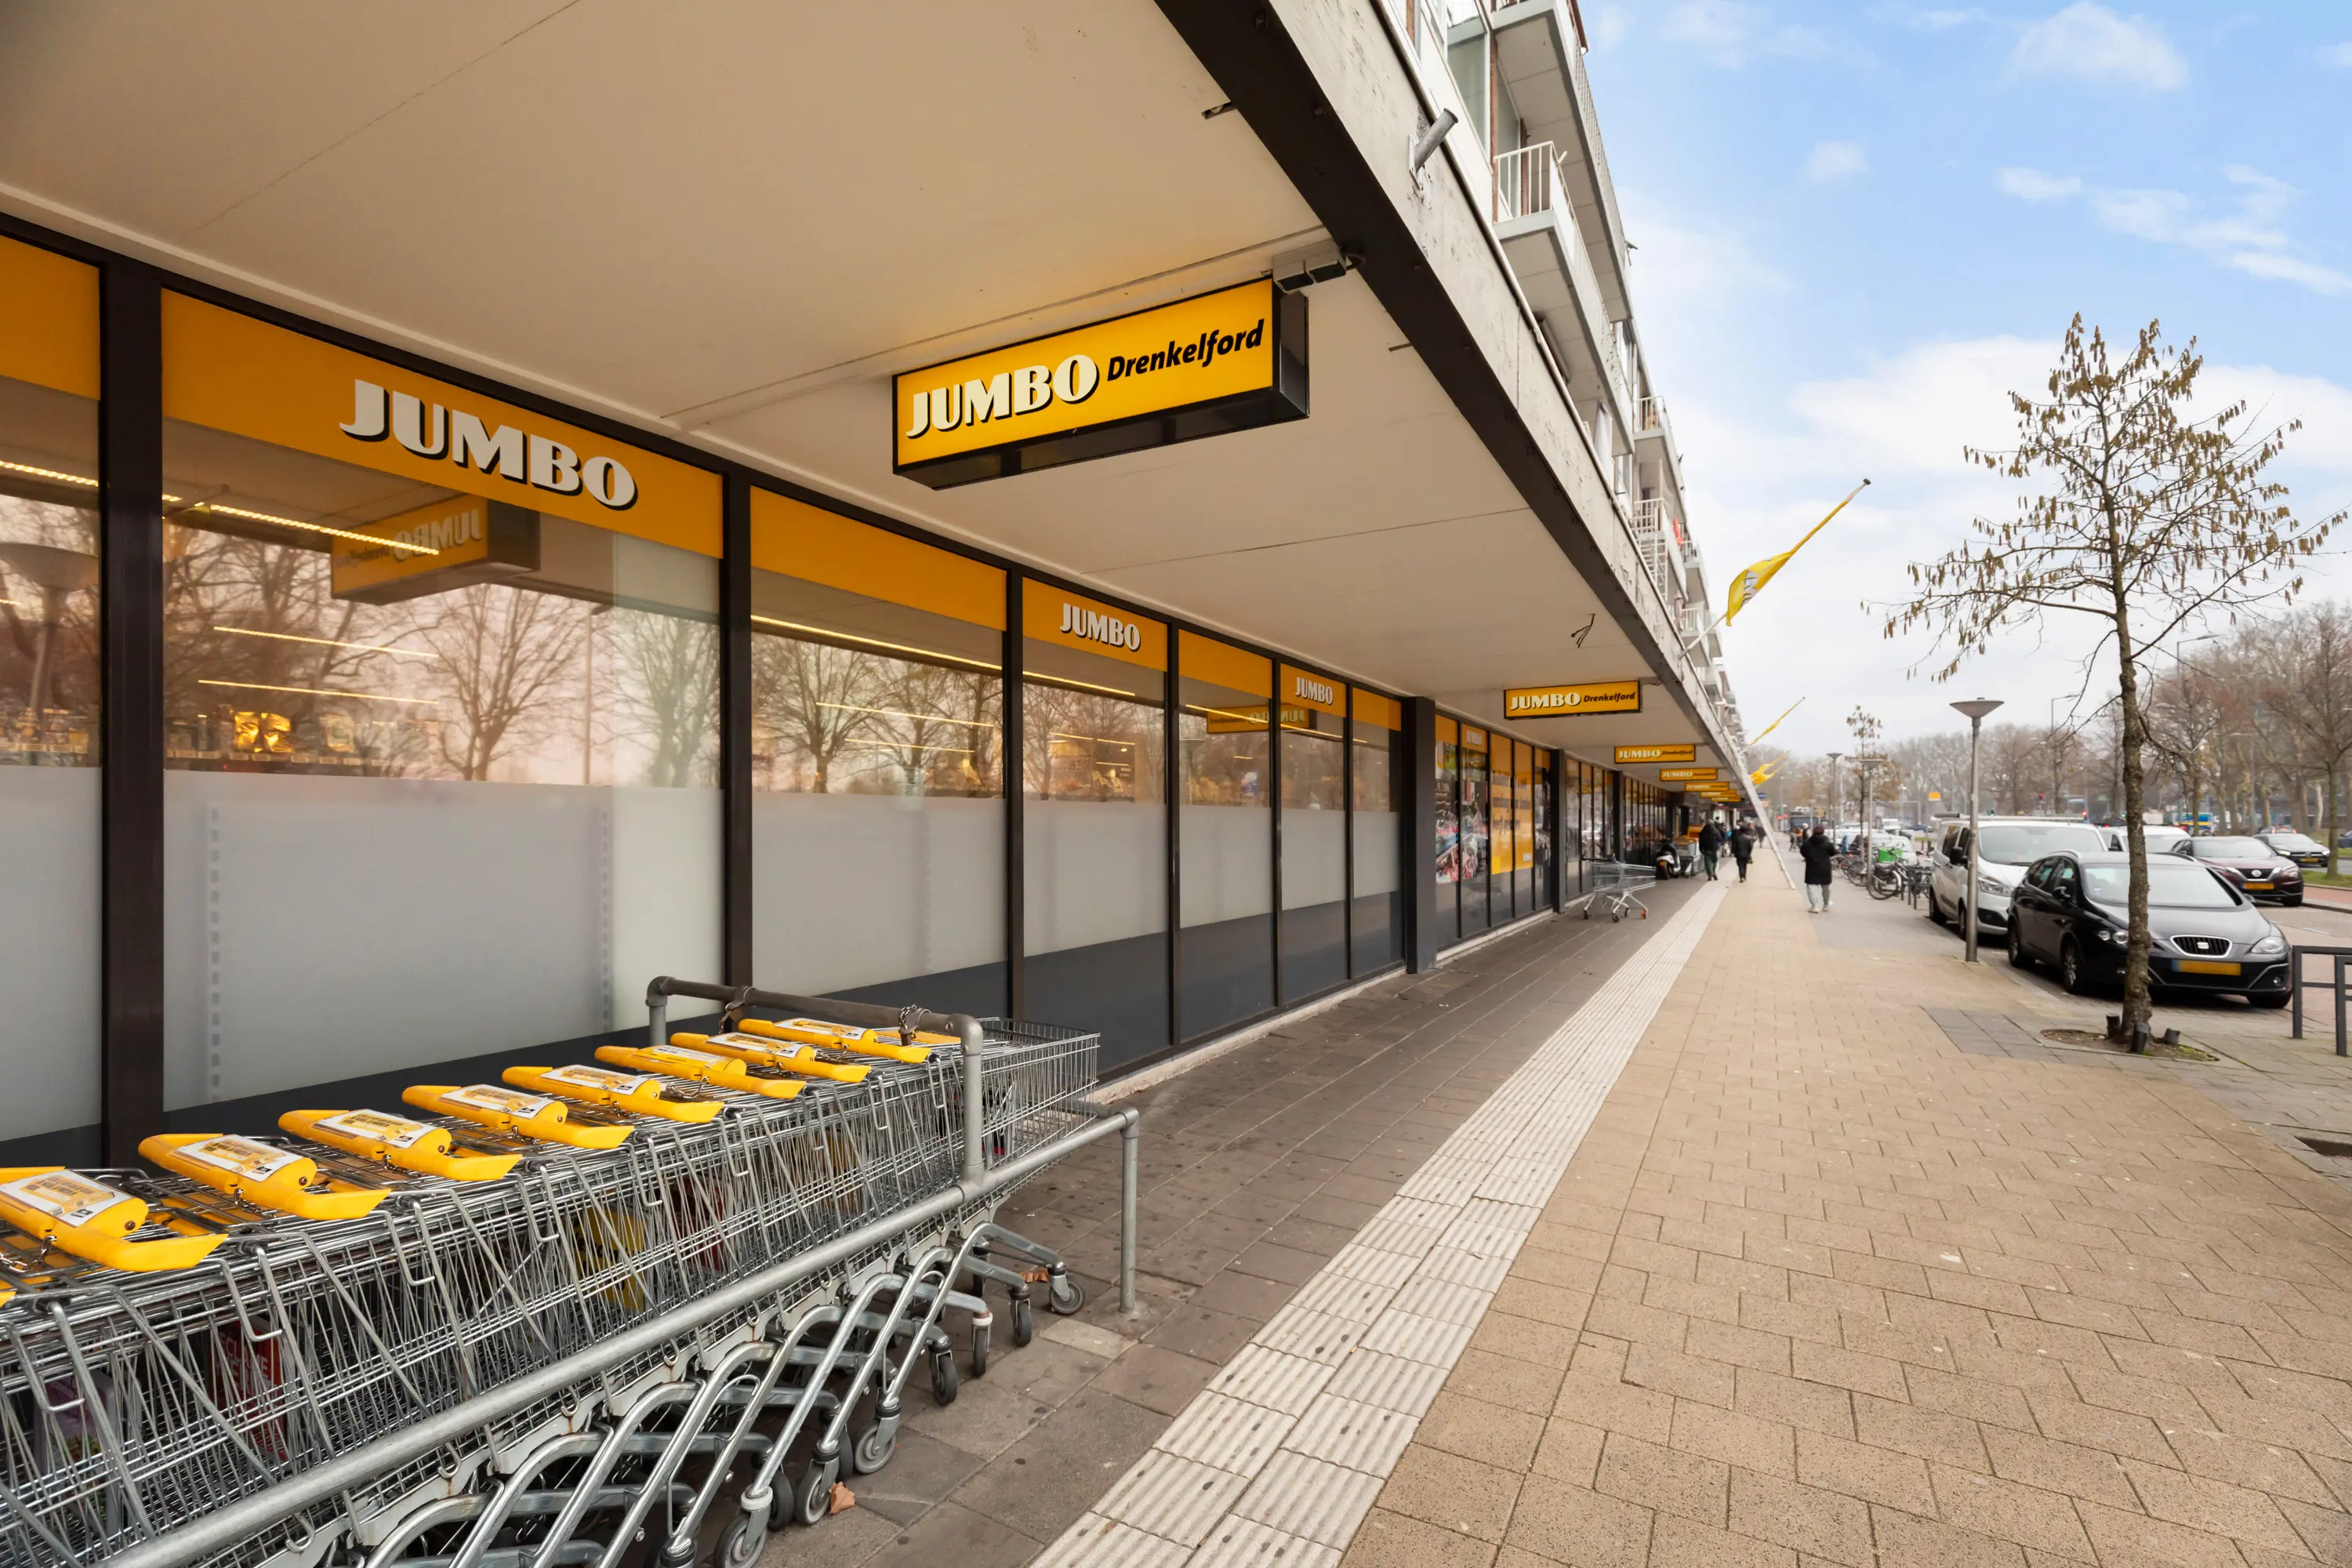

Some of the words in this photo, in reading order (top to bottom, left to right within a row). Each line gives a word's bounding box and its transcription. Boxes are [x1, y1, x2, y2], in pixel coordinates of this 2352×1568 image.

[906, 354, 1099, 439] JUMBO
[1107, 318, 1265, 382] Drenkelford
[339, 379, 638, 511] JUMBO
[1060, 603, 1141, 652] JUMBO
[1295, 677, 1334, 706] JUMBO
[1509, 691, 1581, 711] JUMBO
[1584, 691, 1635, 703] Drenkelford
[1618, 750, 1661, 759] JUMBO
